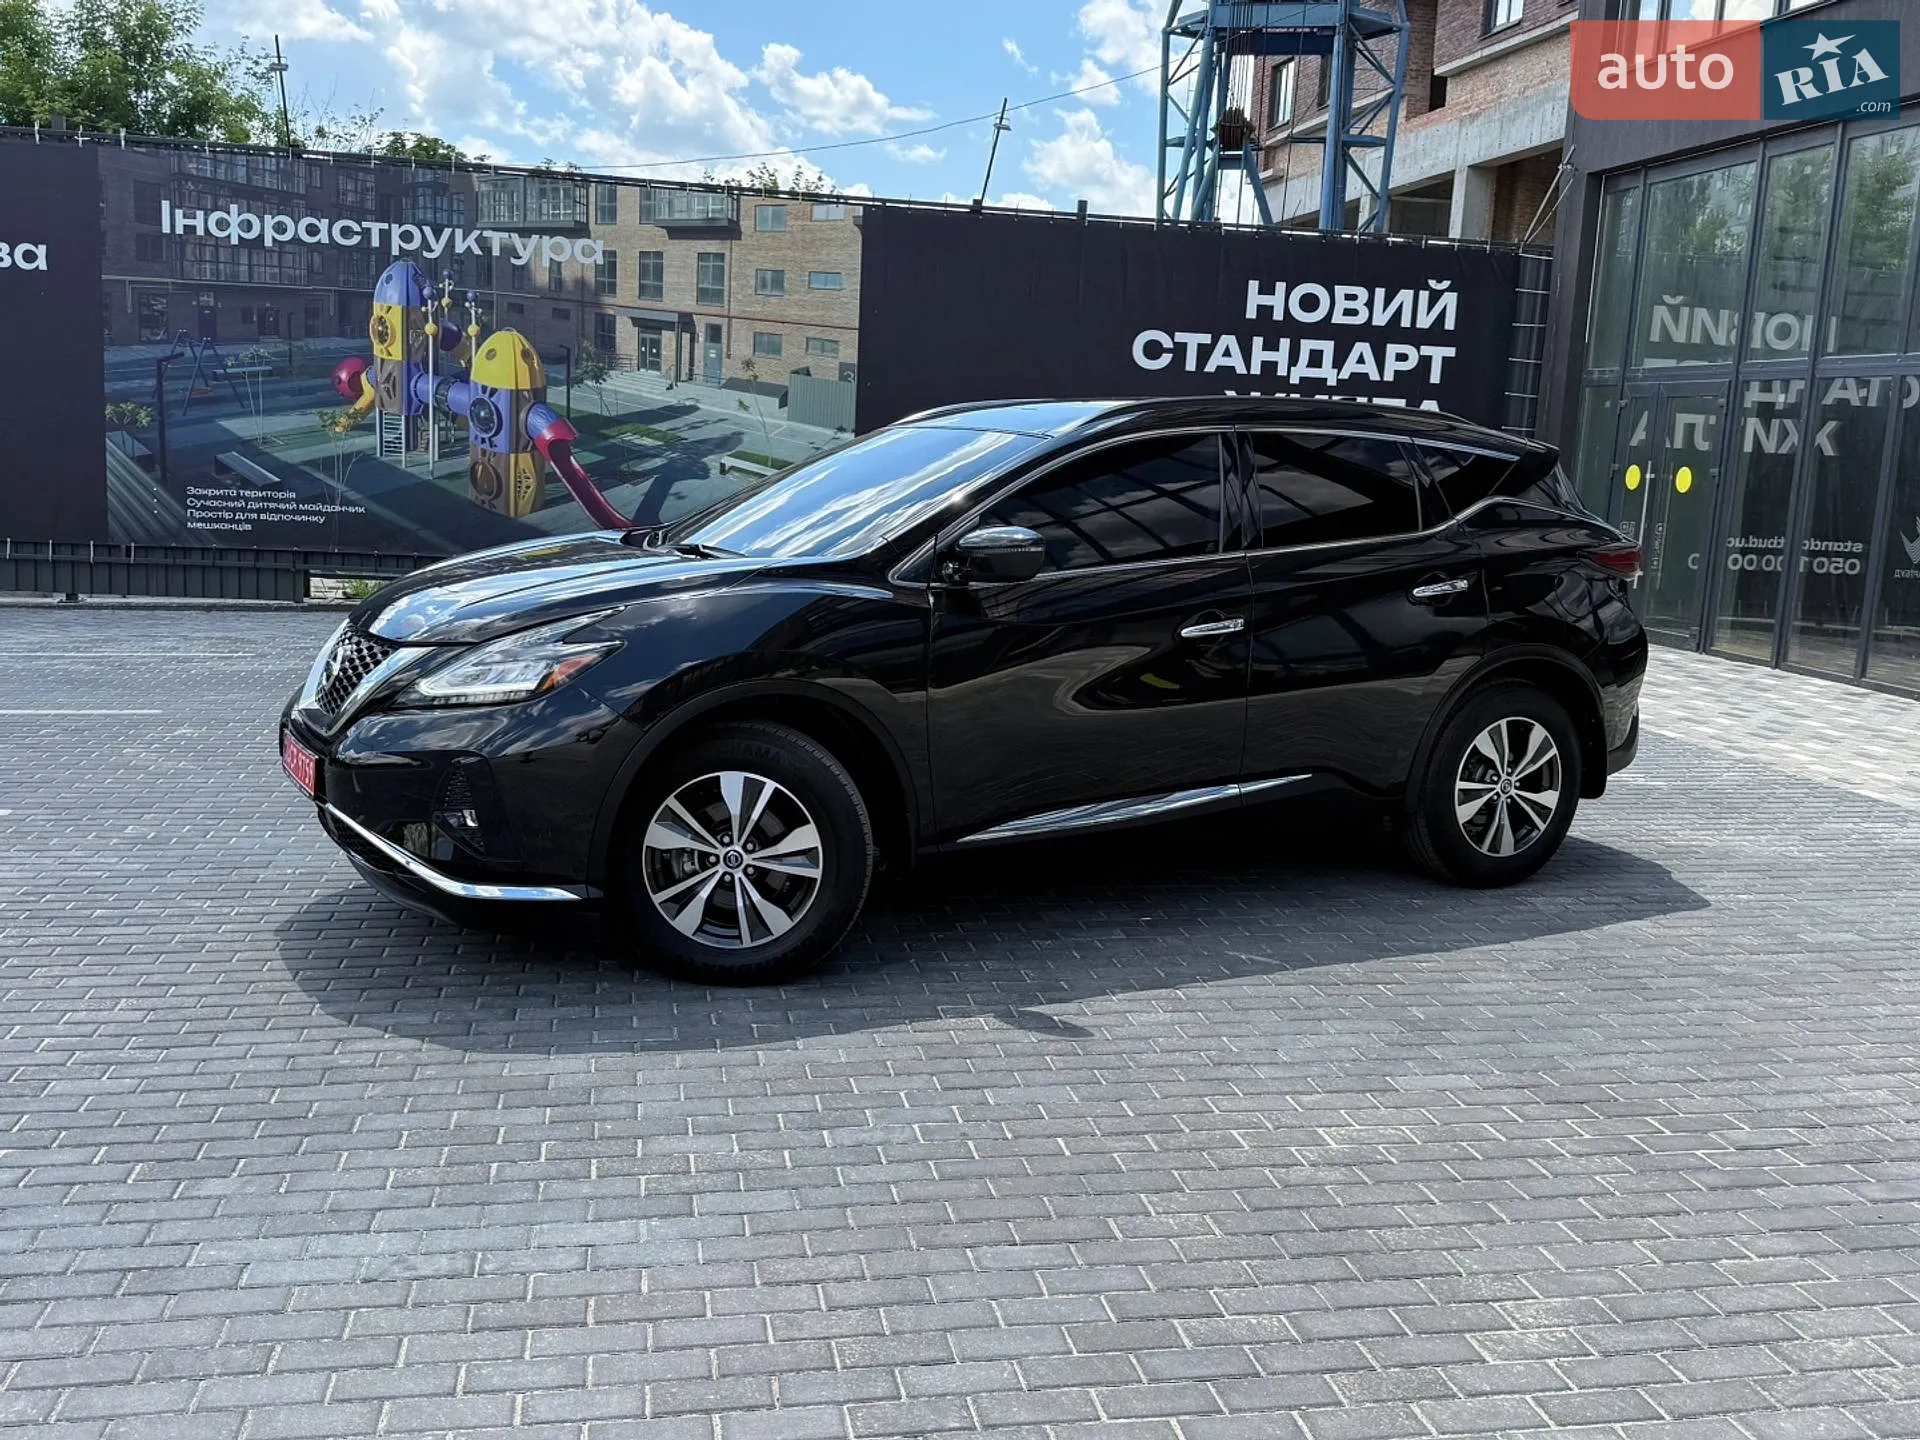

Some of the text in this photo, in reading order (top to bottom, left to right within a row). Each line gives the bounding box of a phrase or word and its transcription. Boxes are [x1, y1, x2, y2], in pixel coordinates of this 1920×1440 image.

[160, 200, 605, 267] Інфраструктура
[1245, 279, 1458, 331] НОВИЙ
[1131, 329, 1457, 386] СТАНДАРТ
[186, 486, 296, 500] Закрита територія
[186, 497, 366, 514] Сучасний дитячий майданчик
[186, 509, 326, 525] Простір для відпочинку
[186, 521, 252, 532] мешканців
